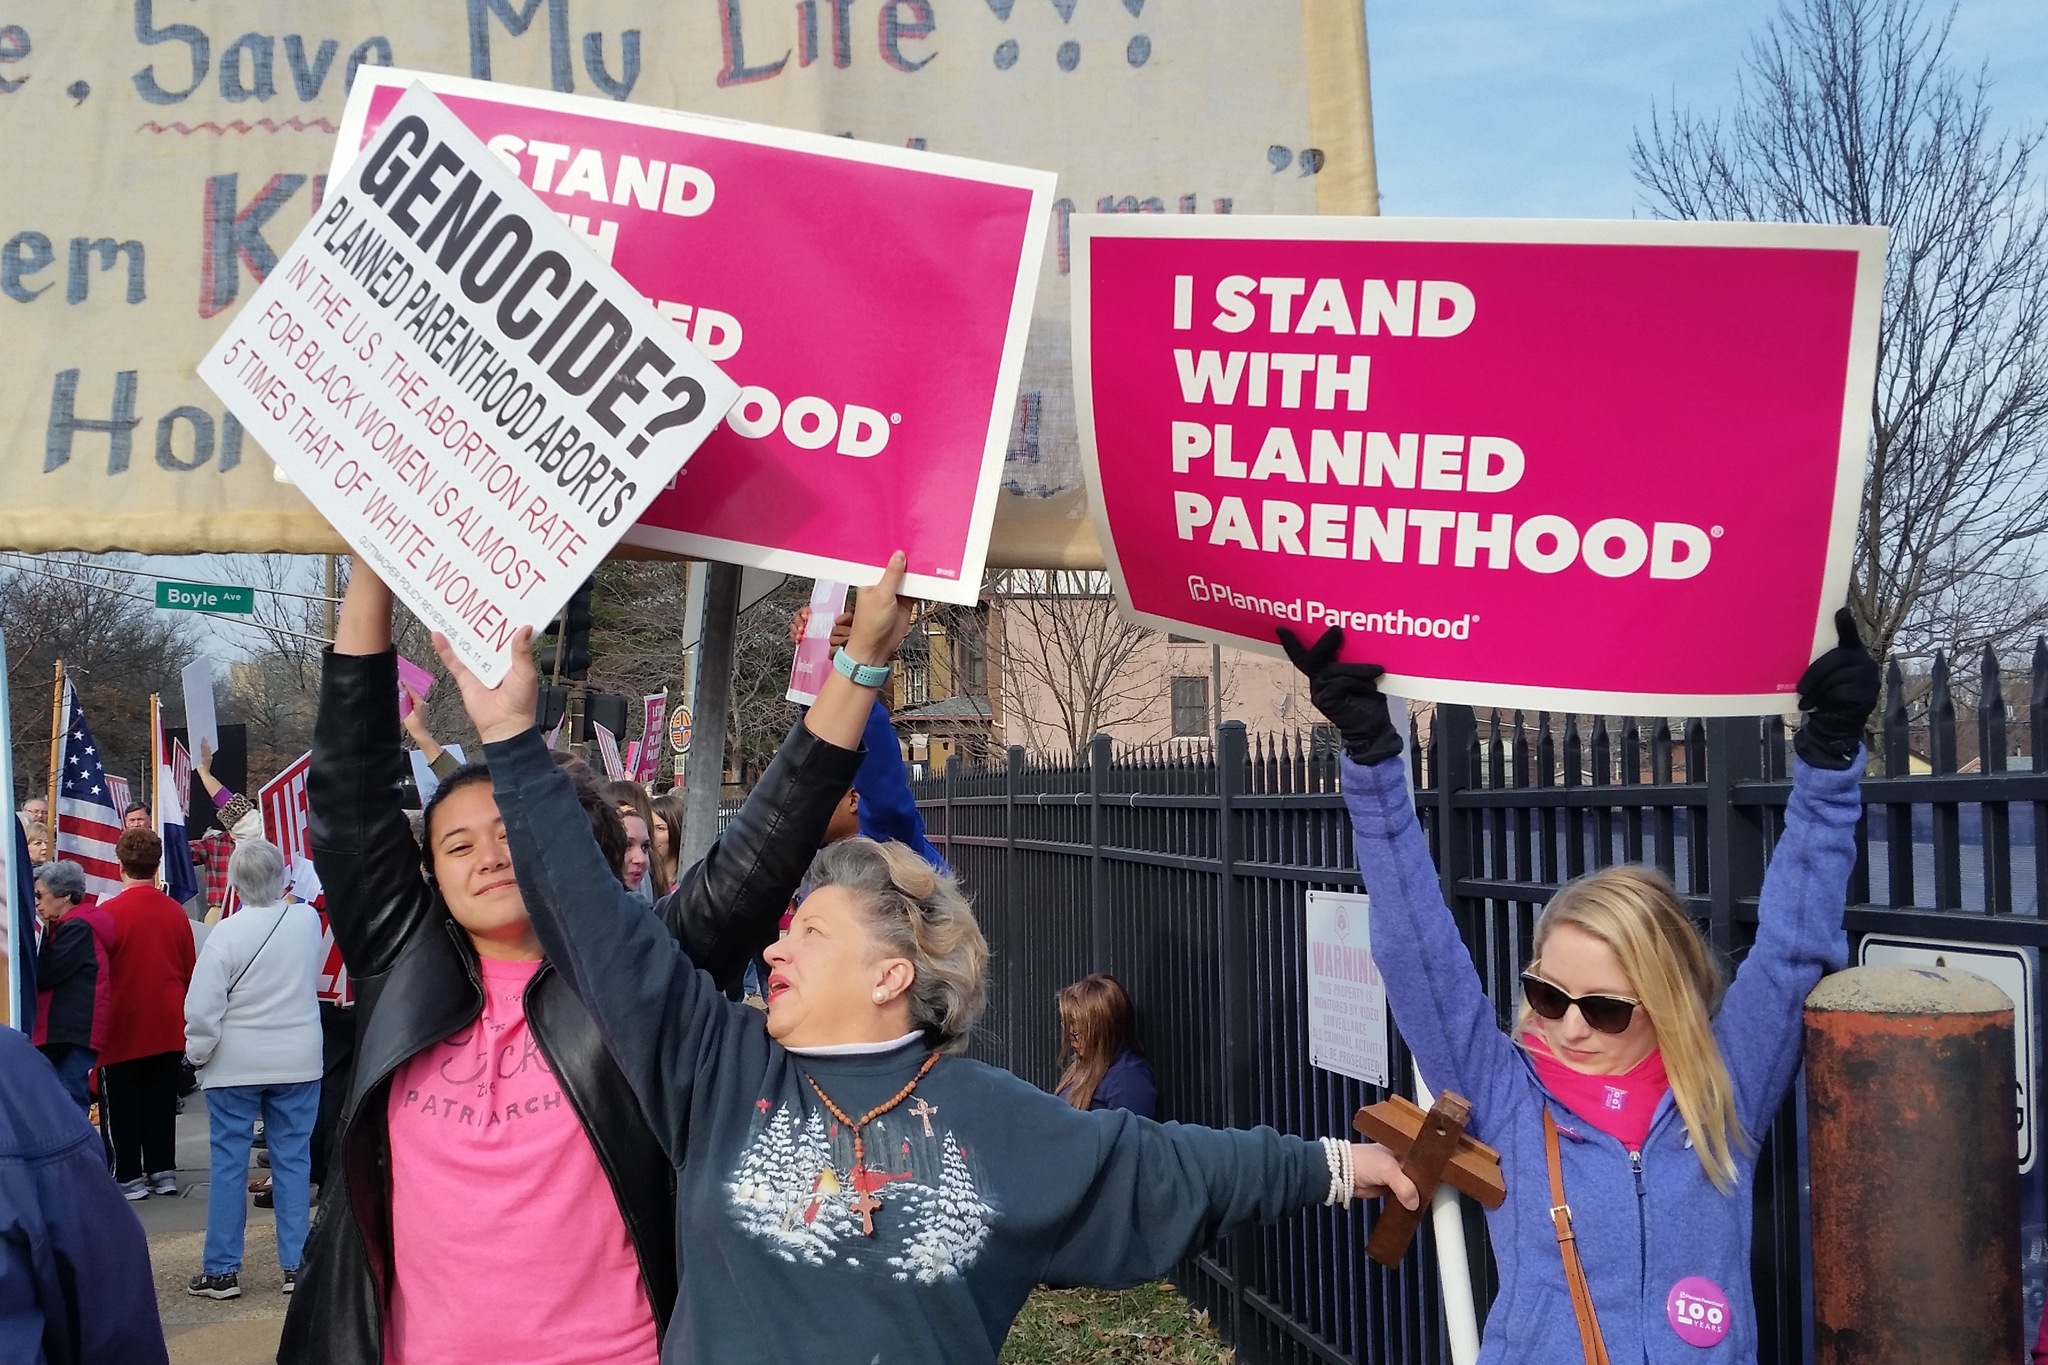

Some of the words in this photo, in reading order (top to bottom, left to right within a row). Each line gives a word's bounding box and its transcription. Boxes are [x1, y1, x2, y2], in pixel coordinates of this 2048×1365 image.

[359, 115, 706, 459] GENOCIDE?
[1173, 275, 1194, 330] I
[1211, 275, 1476, 337] STAND
[313, 195, 414, 309] PLANNED
[394, 279, 547, 440] PARENTHOOD
[524, 415, 637, 527] ABORTS
[1173, 348, 1371, 411] WITH
[285, 254, 316, 291] IN
[306, 274, 352, 329] THE
[342, 312, 383, 368] U.S.
[380, 351, 428, 409] THE
[415, 395, 530, 511] ABORTION
[518, 495, 587, 567] RATE
[258, 300, 304, 356] FOR
[294, 340, 364, 419] BLACK
[354, 401, 438, 495] WOMEN
[427, 480, 459, 517] IS
[447, 506, 546, 600] ALMOST
[1171, 420, 1525, 493] PLANNED
[223, 338, 246, 365] 5
[237, 350, 296, 421] TIMES
[288, 406, 345, 470] THAT
[334, 460, 372, 496] OF
[362, 487, 435, 570] WHITE
[425, 553, 517, 653] WOMEN
[167, 588, 218, 608] Boyle
[223, 592, 242, 601] Ave
[400, 576, 423, 601] POLICY
[1210, 582, 1302, 622] Planned
[1312, 941, 1378, 986] WARNING
[1360, 1006, 1379, 1021] VIDEO
[1675, 1299, 1723, 1325] 100
[1693, 1320, 1722, 1333] YEARS
